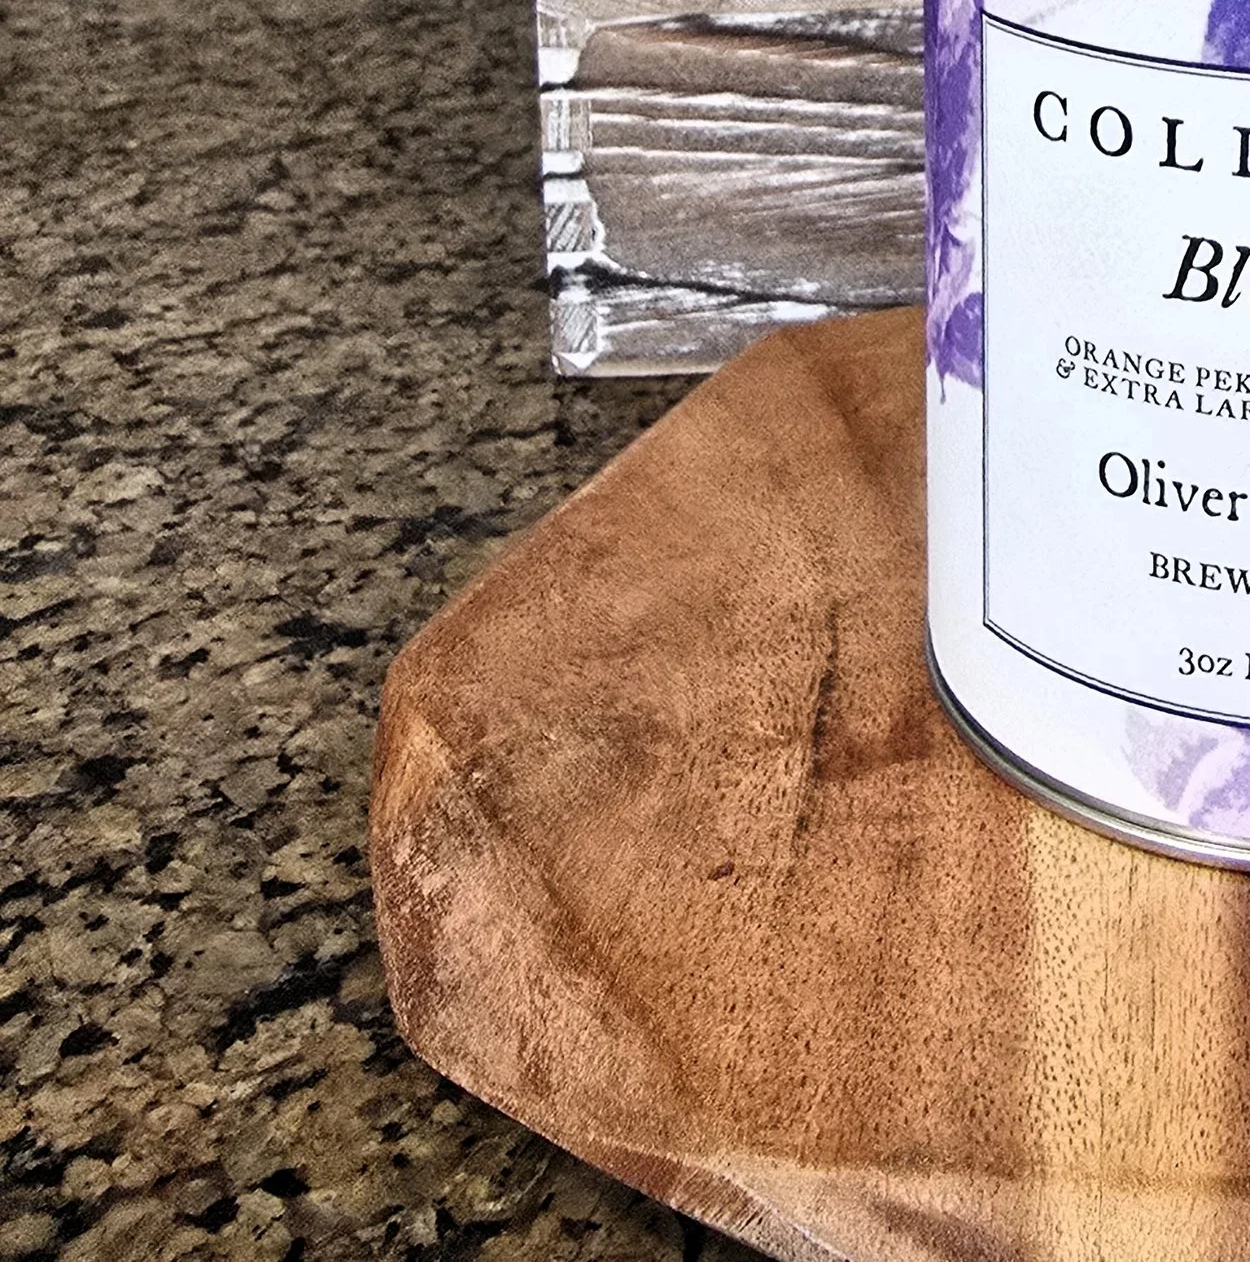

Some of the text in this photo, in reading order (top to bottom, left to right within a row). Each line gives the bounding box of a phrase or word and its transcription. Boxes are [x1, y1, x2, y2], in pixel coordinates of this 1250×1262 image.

[1056, 359, 1076, 379] &
[1083, 368, 1184, 411] EXTRA
[1064, 336, 1187, 384] ORANGE
[1098, 451, 1249, 524] Oliver
[1178, 648, 1234, 679] 3oz
